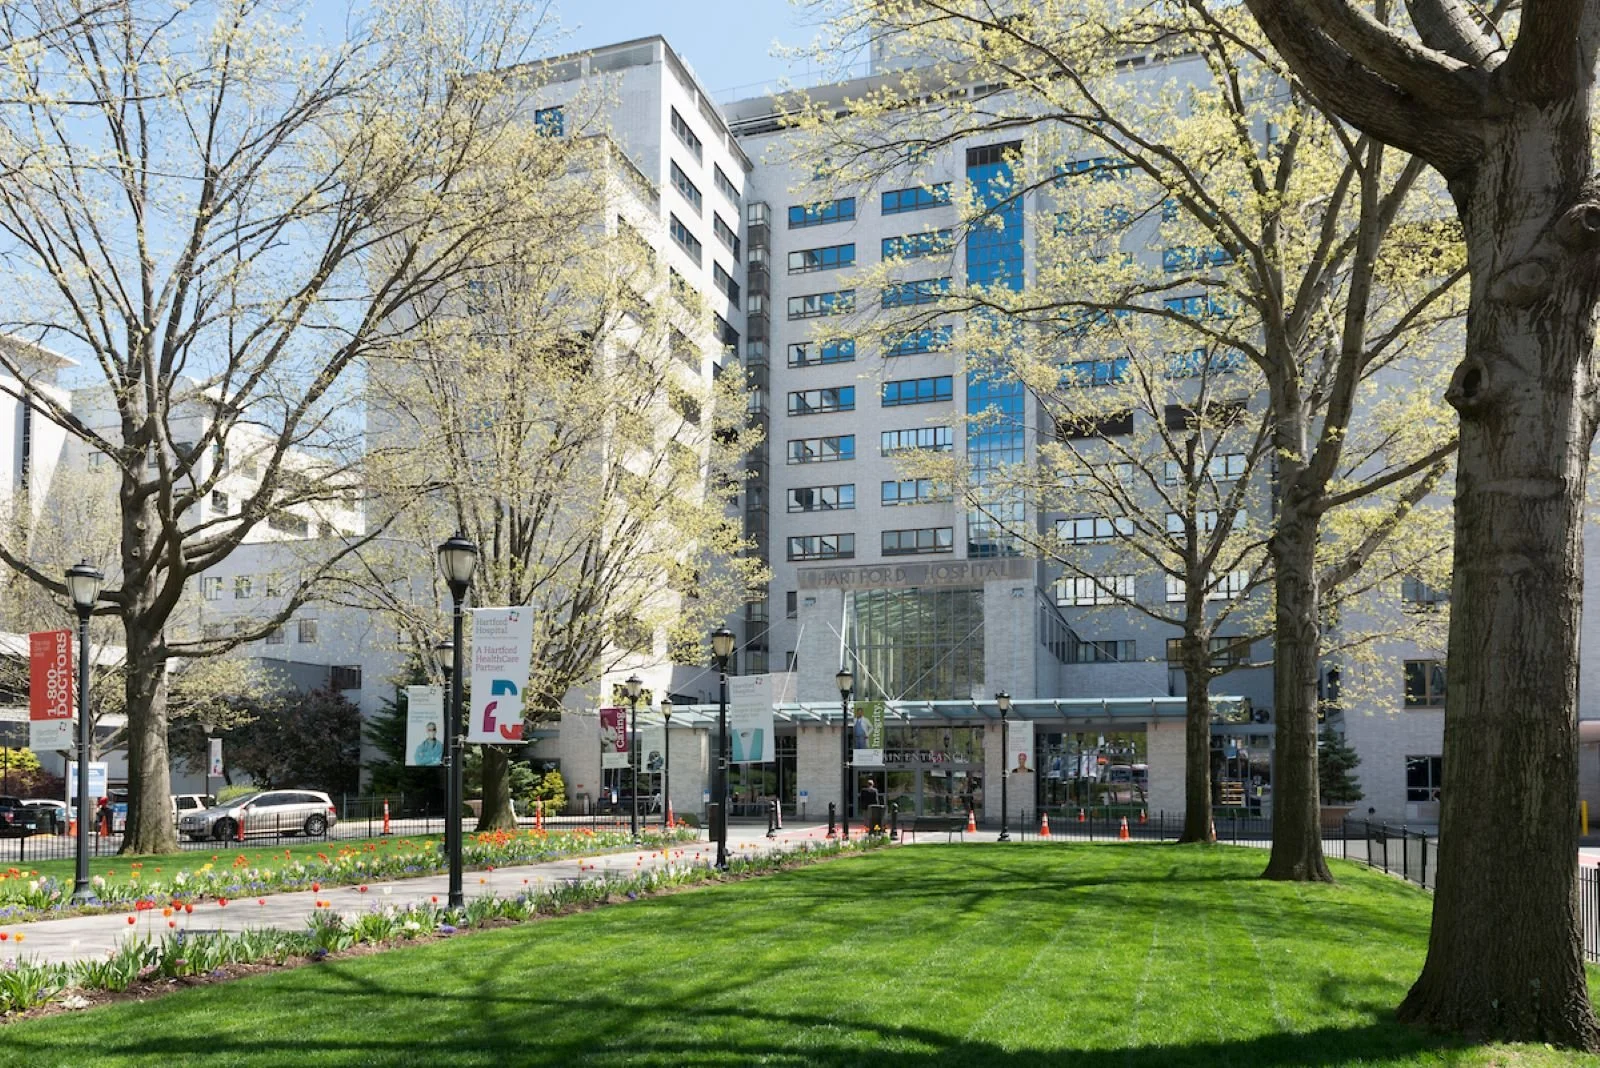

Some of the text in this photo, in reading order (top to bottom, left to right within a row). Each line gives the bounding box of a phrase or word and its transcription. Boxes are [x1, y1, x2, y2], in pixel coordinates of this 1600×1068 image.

[819, 559, 1009, 586] HARTFORD HOSPITAL
[475, 617, 508, 626] Hartford
[475, 626, 508, 636] Hospital
[475, 646, 518, 654] A Hartford
[475, 655, 520, 663] HealthCare
[57, 632, 68, 716] DOCTORS
[47, 662, 57, 716] 1-800-
